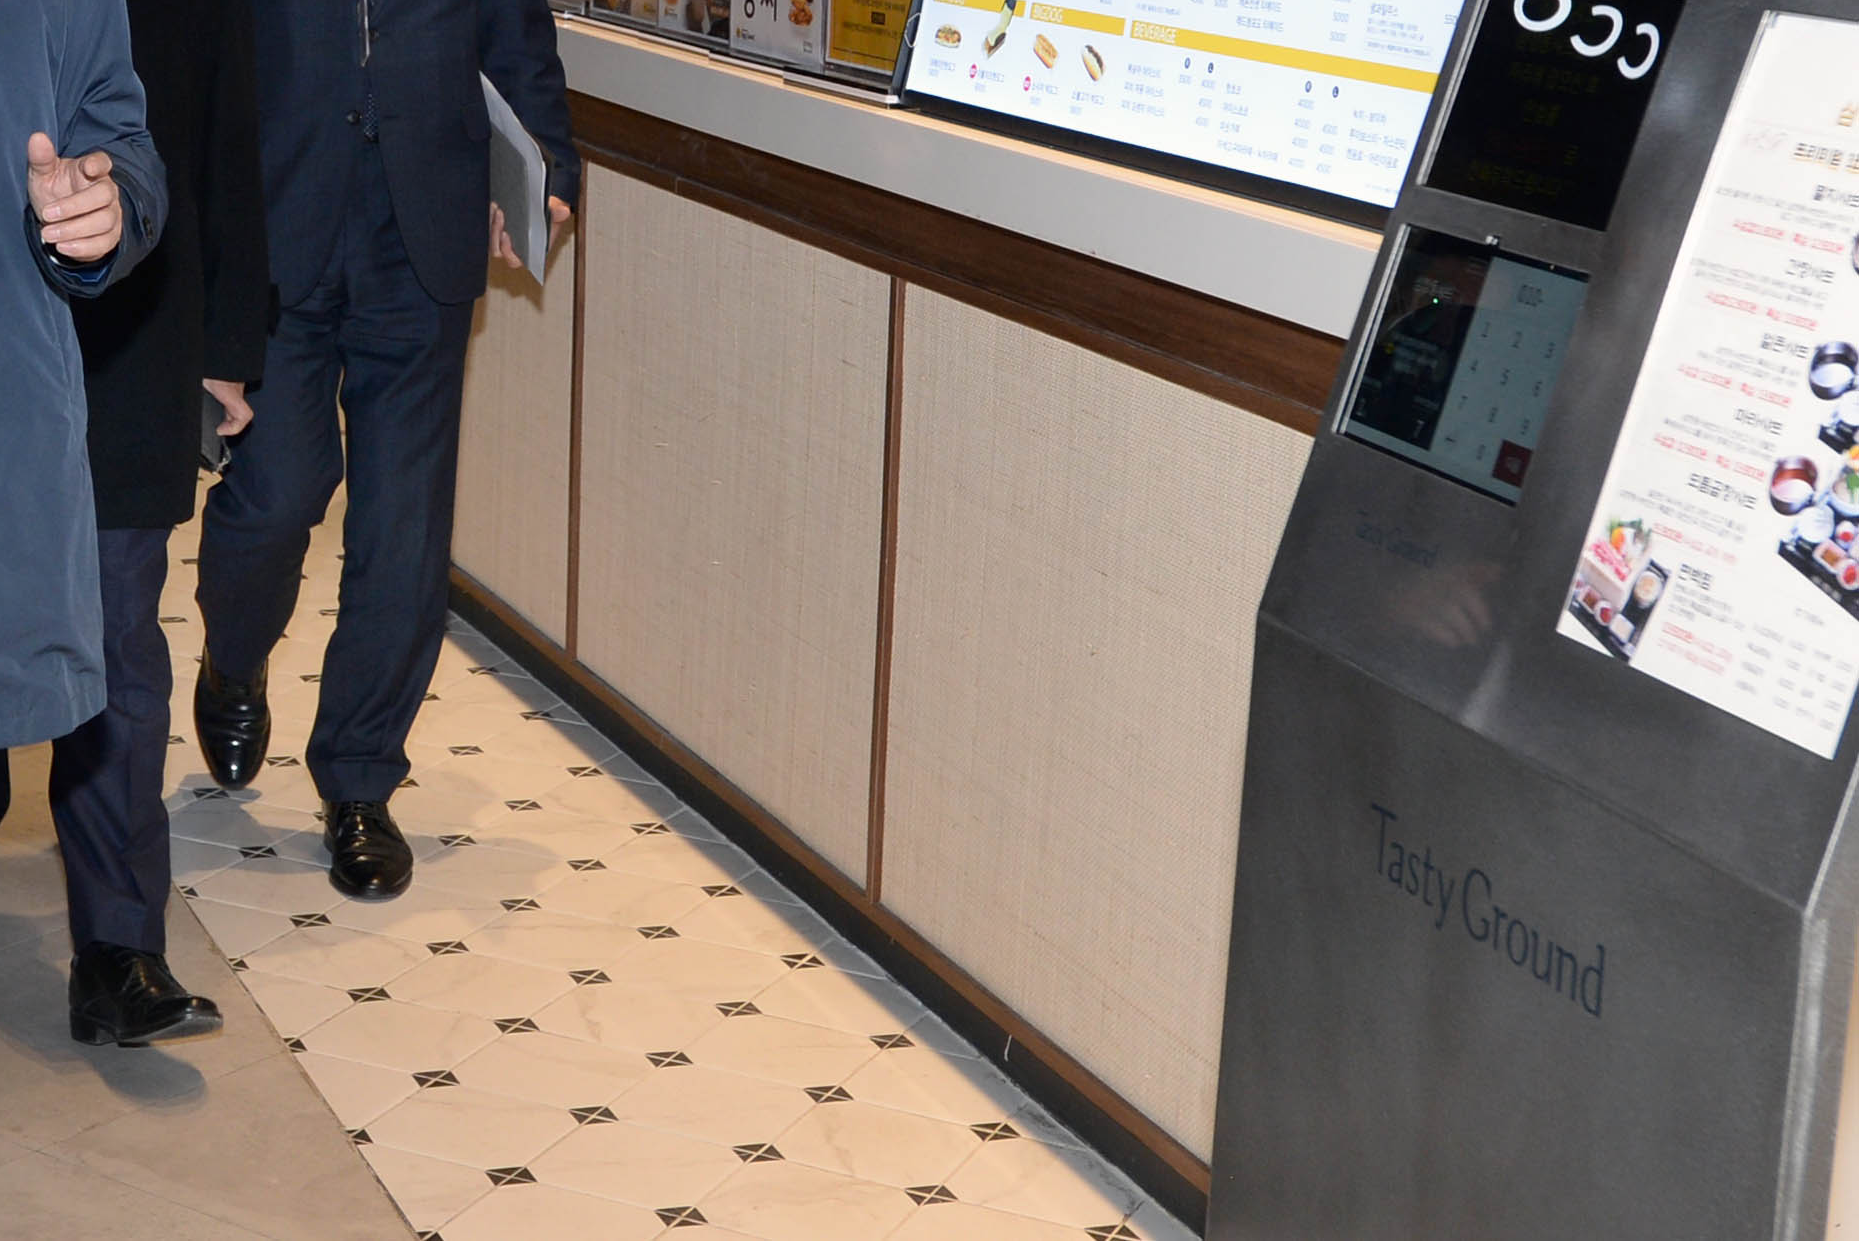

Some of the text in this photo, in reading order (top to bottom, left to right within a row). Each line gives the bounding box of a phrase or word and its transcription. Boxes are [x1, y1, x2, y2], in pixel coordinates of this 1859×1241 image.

[1133, 21, 1178, 45] BEVERAGE
[1370, 801, 1607, 1020] Tasty Ground
